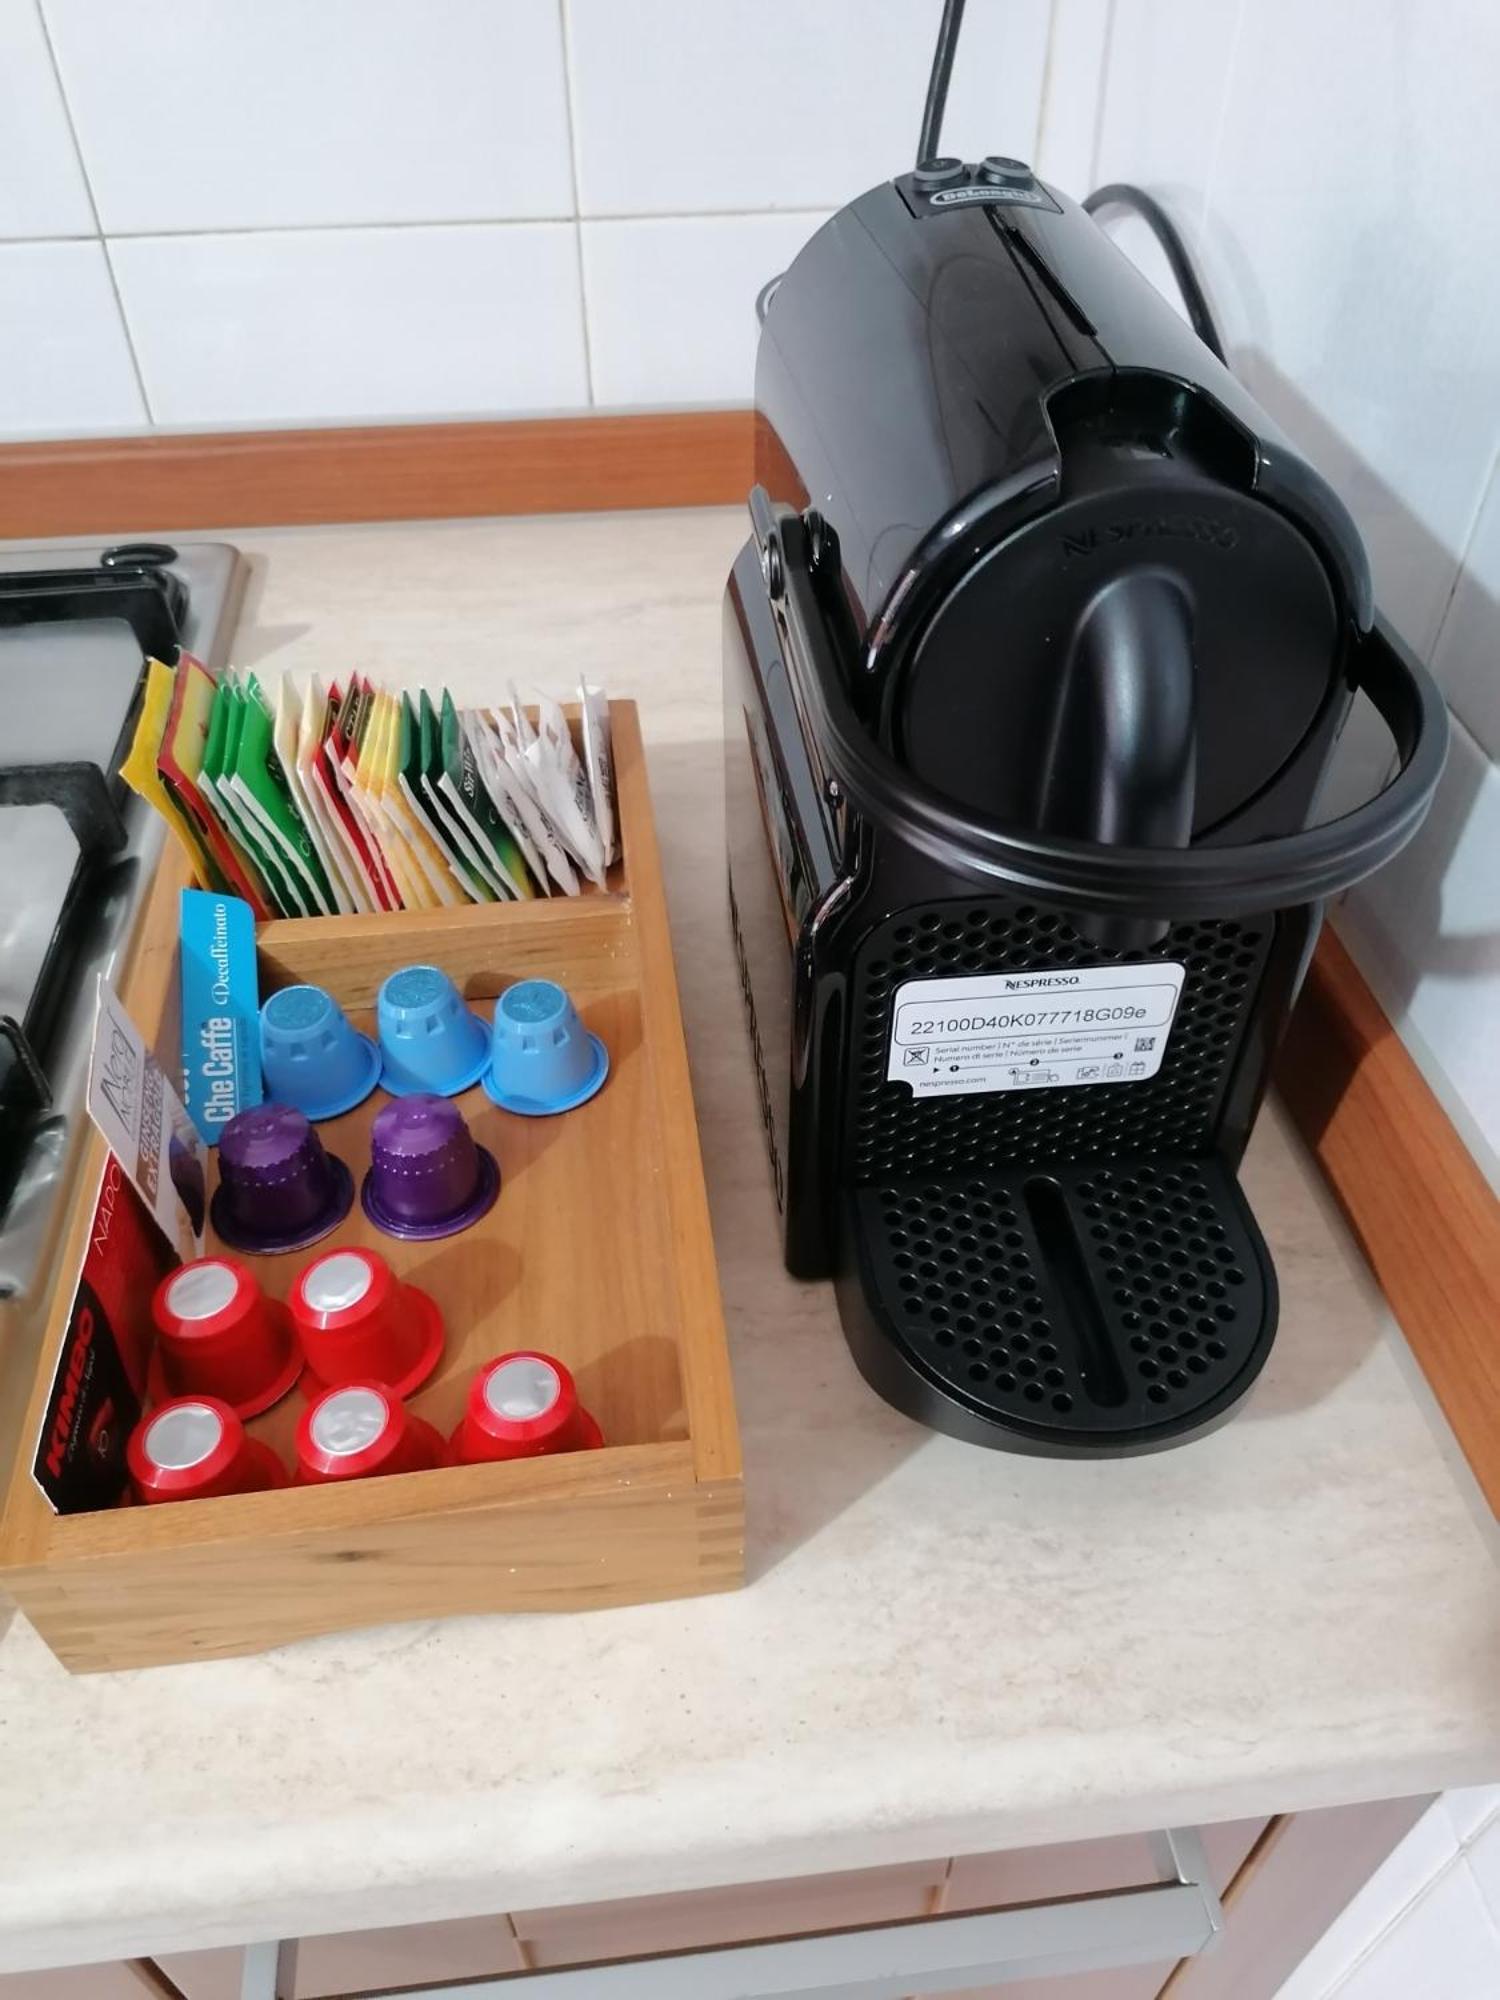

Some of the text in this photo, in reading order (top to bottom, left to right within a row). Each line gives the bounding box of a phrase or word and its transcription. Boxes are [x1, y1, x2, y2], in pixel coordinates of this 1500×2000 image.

[210, 903, 227, 1005] Decaffeinato
[1005, 976, 1079, 990] NESPRESSO
[910, 1006, 1146, 1035] 22100D40K077718G09e
[919, 1076, 986, 1088] nespresso.com
[203, 1083, 230, 1123] Che
[46, 1307, 94, 1479] KIMBO
